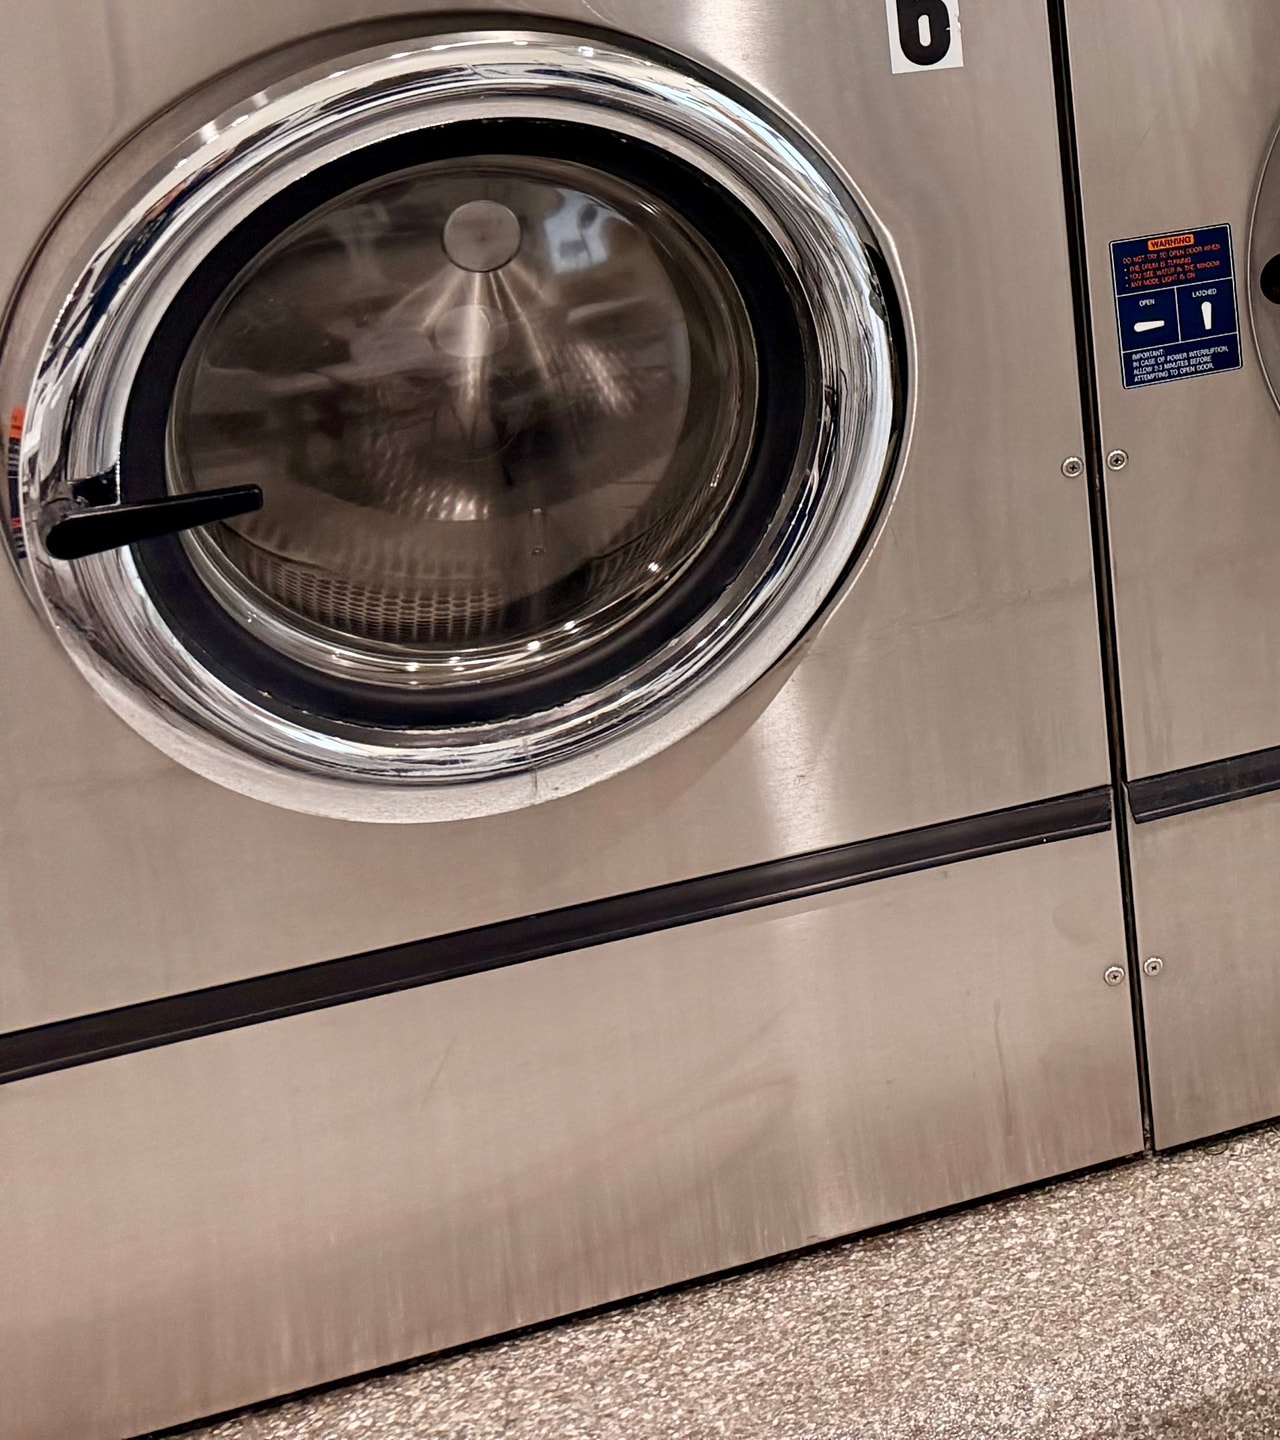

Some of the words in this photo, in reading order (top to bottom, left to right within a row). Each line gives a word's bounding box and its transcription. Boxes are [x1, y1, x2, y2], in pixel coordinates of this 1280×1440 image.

[1150, 236, 1191, 248] WARNING
[1192, 289, 1217, 298] LATCHED
[1133, 360, 1140, 368] IN
[1141, 358, 1156, 366] CASE
[1167, 354, 1187, 362] POWER
[1134, 366, 1153, 375] ALLOW
[1164, 361, 1188, 370] MINUTES
[1190, 356, 1212, 365] BEFORE
[1134, 371, 1169, 382] ATTEMPTING
[1180, 366, 1195, 374] OPEN
